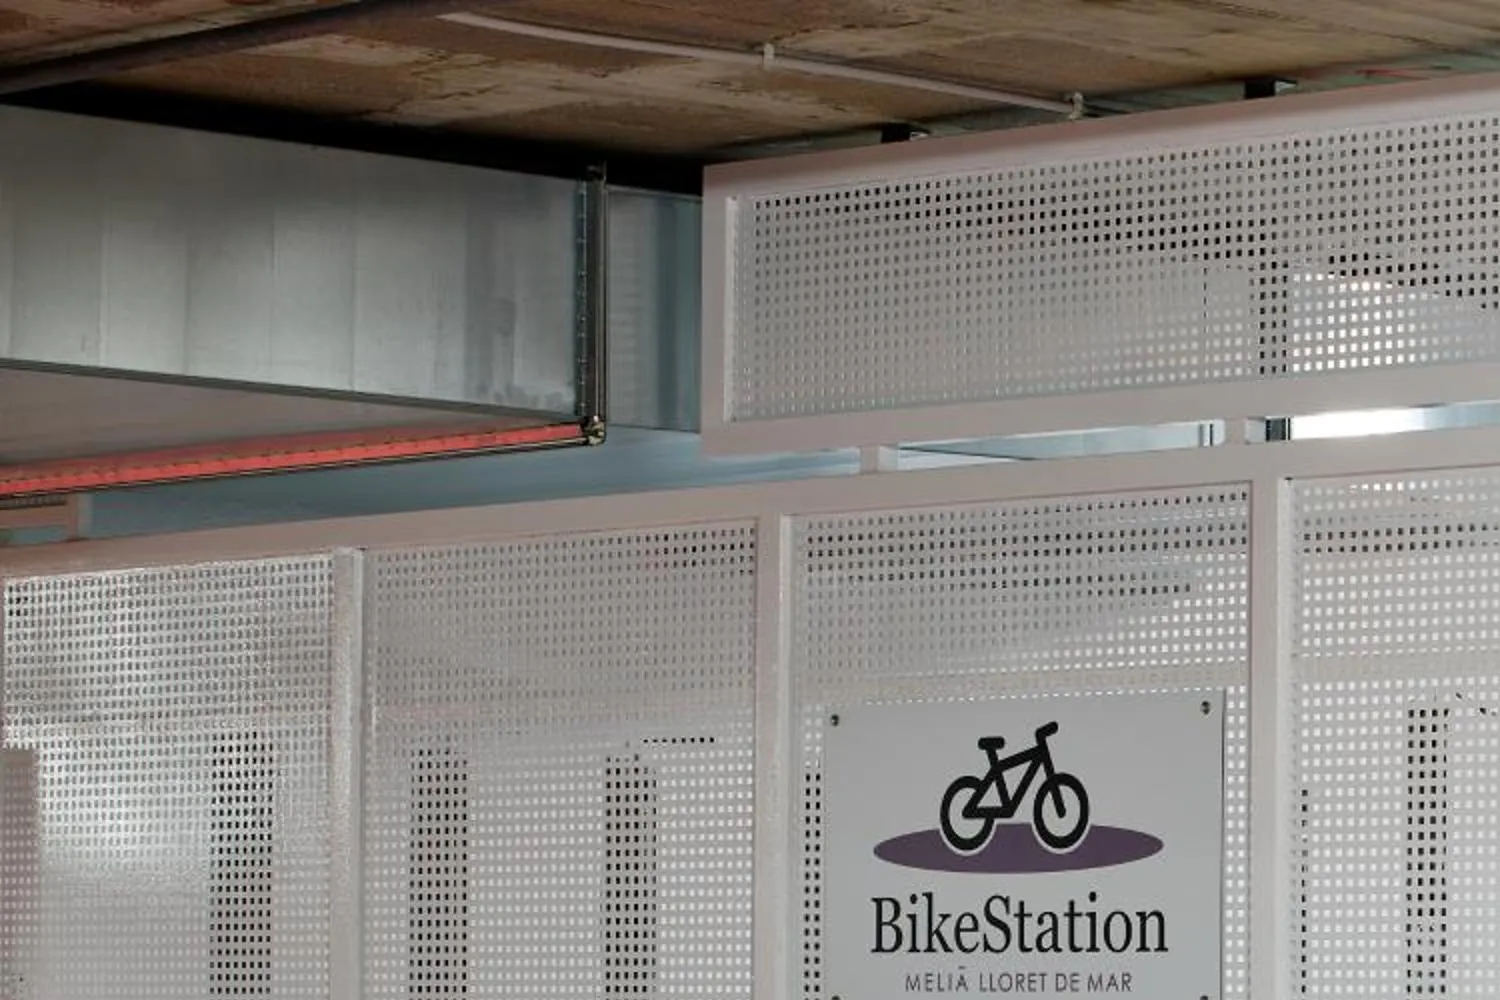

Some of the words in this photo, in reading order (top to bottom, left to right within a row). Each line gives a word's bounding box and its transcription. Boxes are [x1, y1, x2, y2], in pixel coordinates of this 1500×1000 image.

[870, 891, 1169, 954] BikeStation
[979, 972, 1048, 993] LLORET
[1055, 973, 1080, 993] DE
[1087, 973, 1133, 993] MAR
